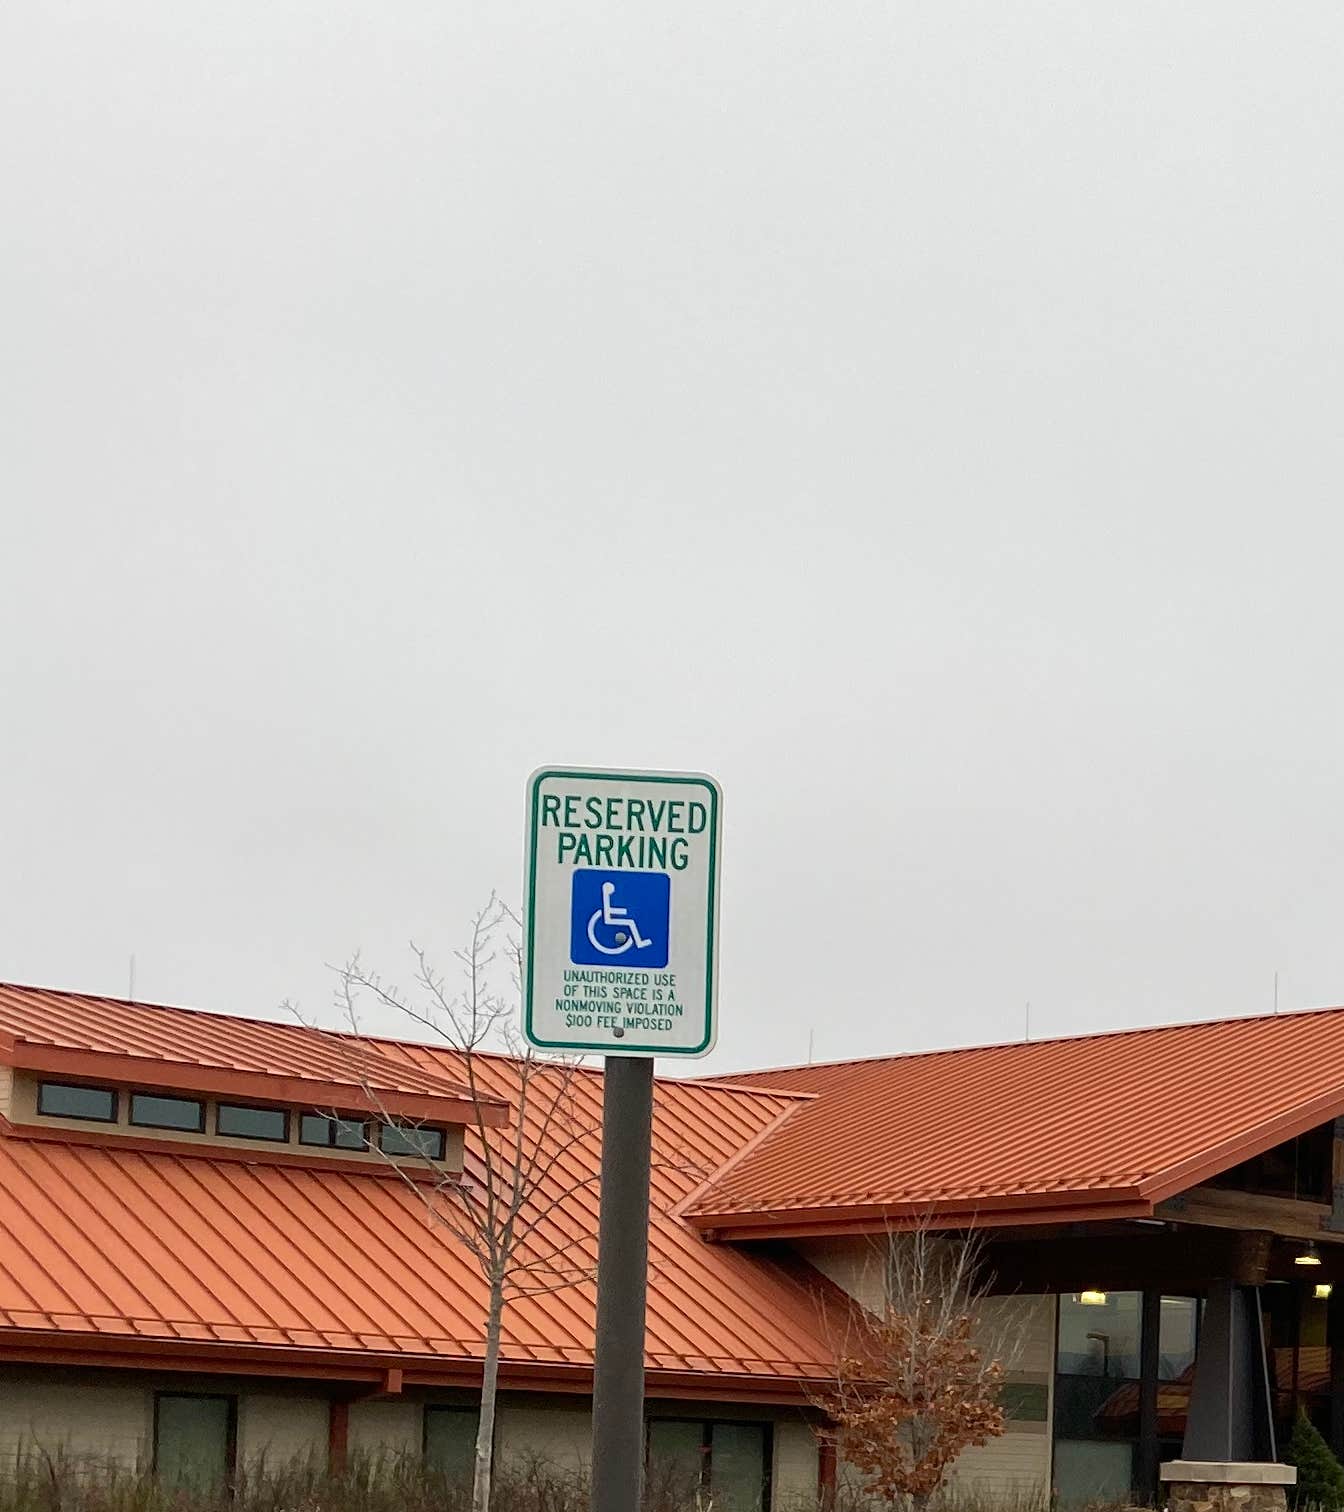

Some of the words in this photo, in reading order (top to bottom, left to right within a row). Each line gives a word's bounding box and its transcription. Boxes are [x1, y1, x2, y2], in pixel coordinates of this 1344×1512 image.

[542, 795, 707, 833] RESERVED
[558, 832, 688, 870] PARKING
[564, 970, 649, 985] UNAUTHORIZED
[654, 974, 676, 986] USE
[564, 985, 578, 996] OF
[584, 986, 607, 998] THIS
[613, 987, 647, 1000] SPACE
[653, 989, 662, 1000] IS
[668, 990, 675, 1000] A
[556, 999, 621, 1013] NONMOVING
[627, 1003, 683, 1016] VIOLATION
[566, 1013, 592, 1027] $100
[598, 1016, 617, 1028] FEE
[623, 1017, 672, 1030] IMPOSED
